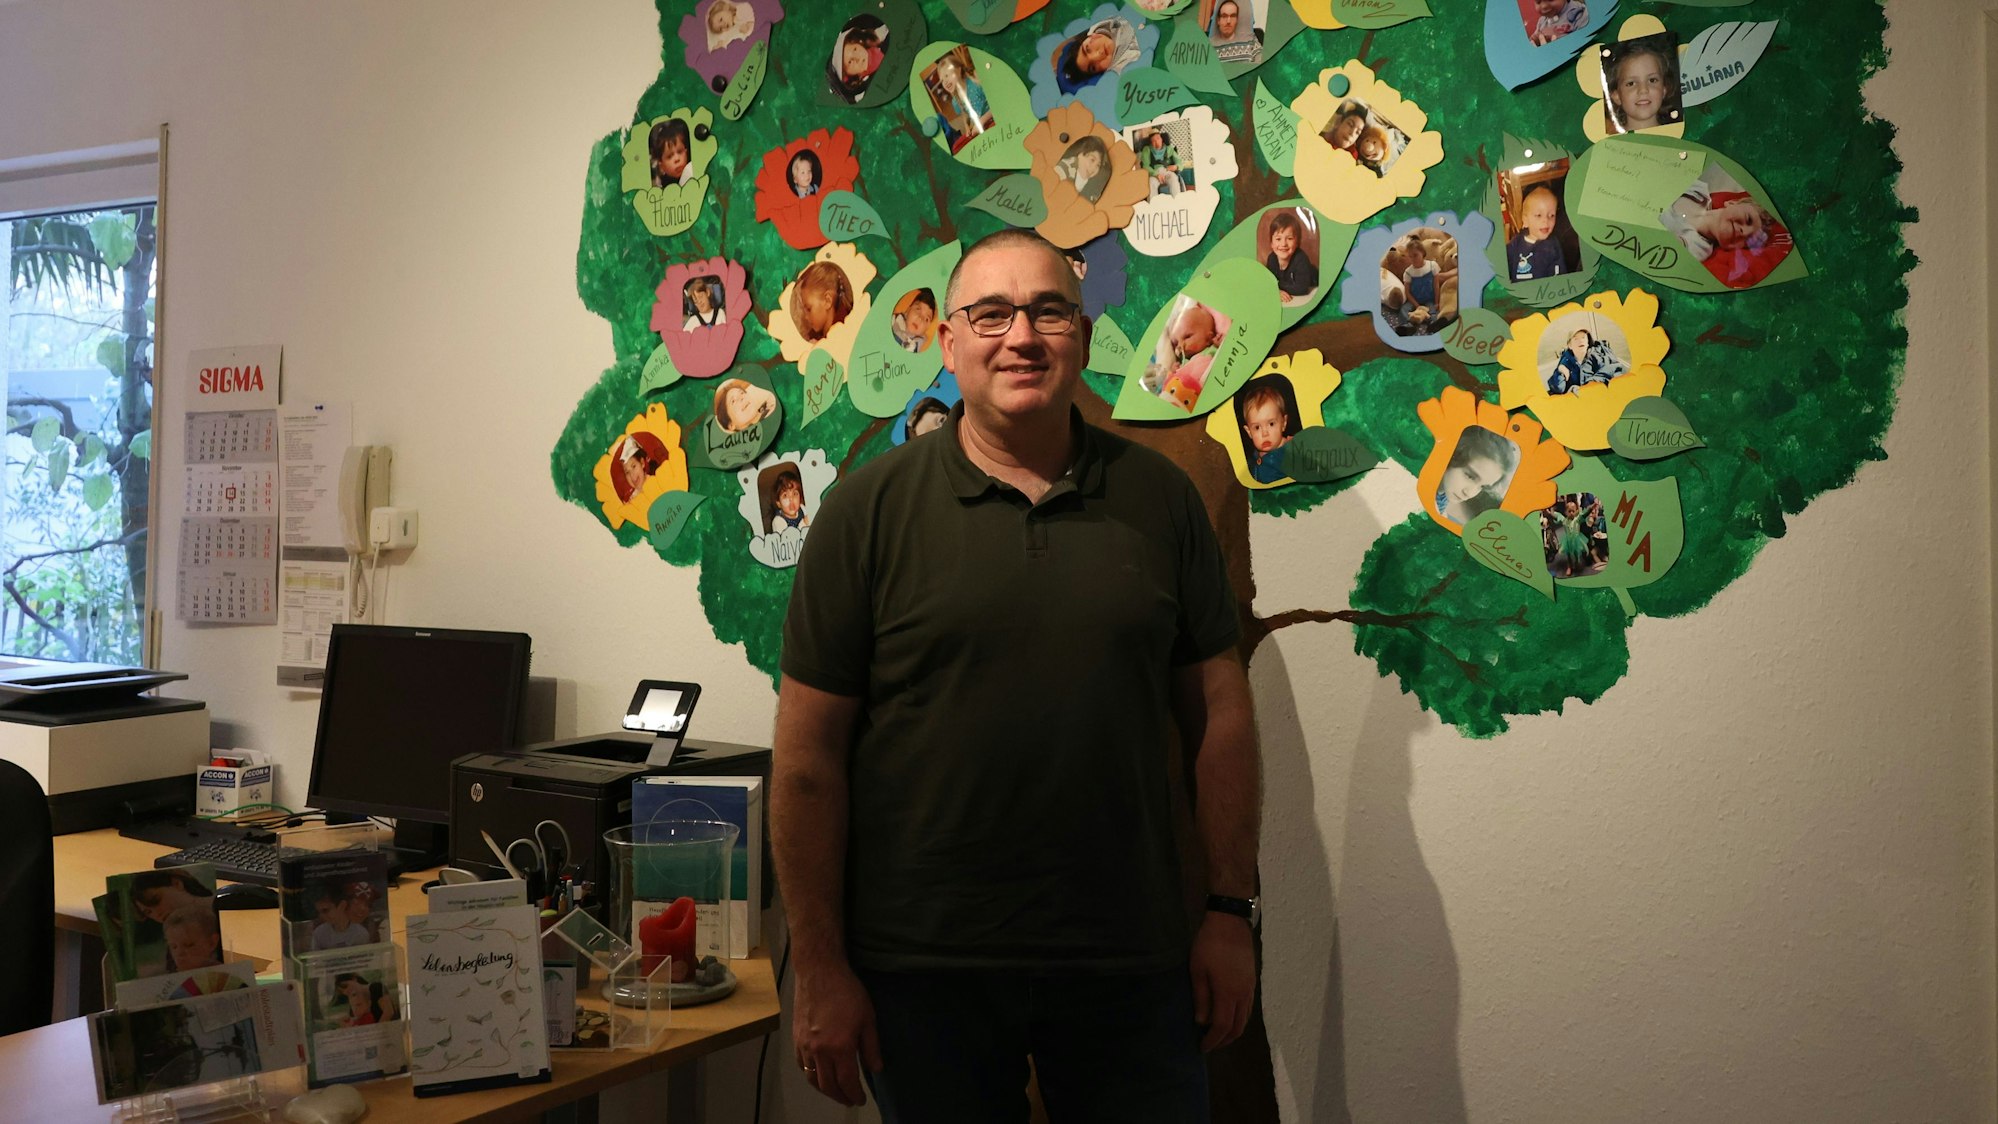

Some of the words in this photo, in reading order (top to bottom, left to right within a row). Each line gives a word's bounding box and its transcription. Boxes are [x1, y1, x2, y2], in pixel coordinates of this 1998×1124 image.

[1169, 42, 1209, 66] ARMIN
[1680, 60, 1745, 94] GIULIANA
[1123, 82, 1180, 117] YUSUF
[969, 125, 1025, 164] Mathilda
[648, 194, 692, 228] Florian
[986, 185, 1033, 217] Malek
[827, 203, 874, 234] THEO
[1136, 210, 1195, 241] MICHAEL
[1591, 224, 1679, 271] DAVID
[1535, 279, 1578, 303] Noah
[1444, 314, 1505, 356] Neel
[200, 365, 264, 394] SIGMA
[858, 351, 912, 386] Fabian
[706, 419, 761, 452] Laura
[1619, 416, 1697, 448] Thomas
[1291, 440, 1360, 480] Margaux
[1477, 520, 1525, 572] Elena
[1611, 490, 1652, 573] MIA
[203, 771, 228, 779] ACCON
[244, 768, 264, 778] ACCON
[472, 783, 483, 802] hp
